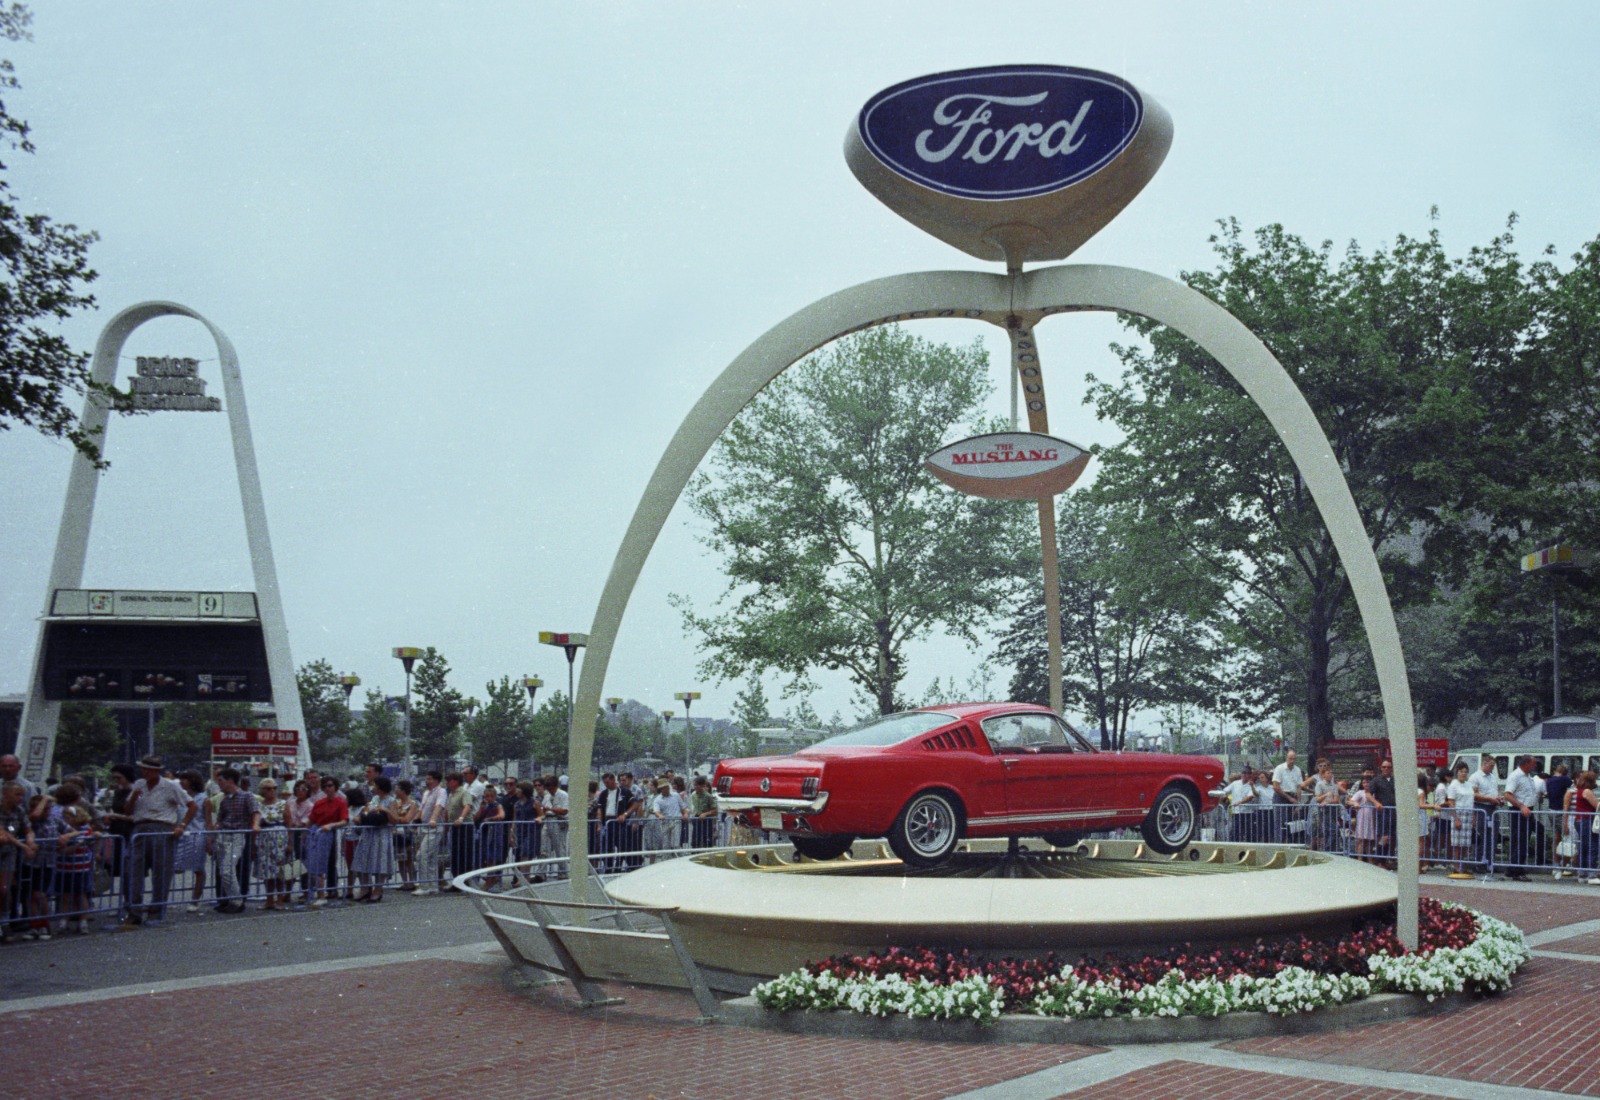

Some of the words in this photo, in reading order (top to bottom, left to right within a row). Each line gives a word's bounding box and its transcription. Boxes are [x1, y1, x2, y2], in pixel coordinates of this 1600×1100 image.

[915, 91, 1094, 164] Ford
[136, 356, 199, 376] PEACE
[994, 443, 1014, 451] THE
[951, 448, 1058, 465] MUSTANG
[120, 595, 149, 603] GENERAL
[174, 596, 192, 604] ARCH
[204, 596, 217, 612] 9
